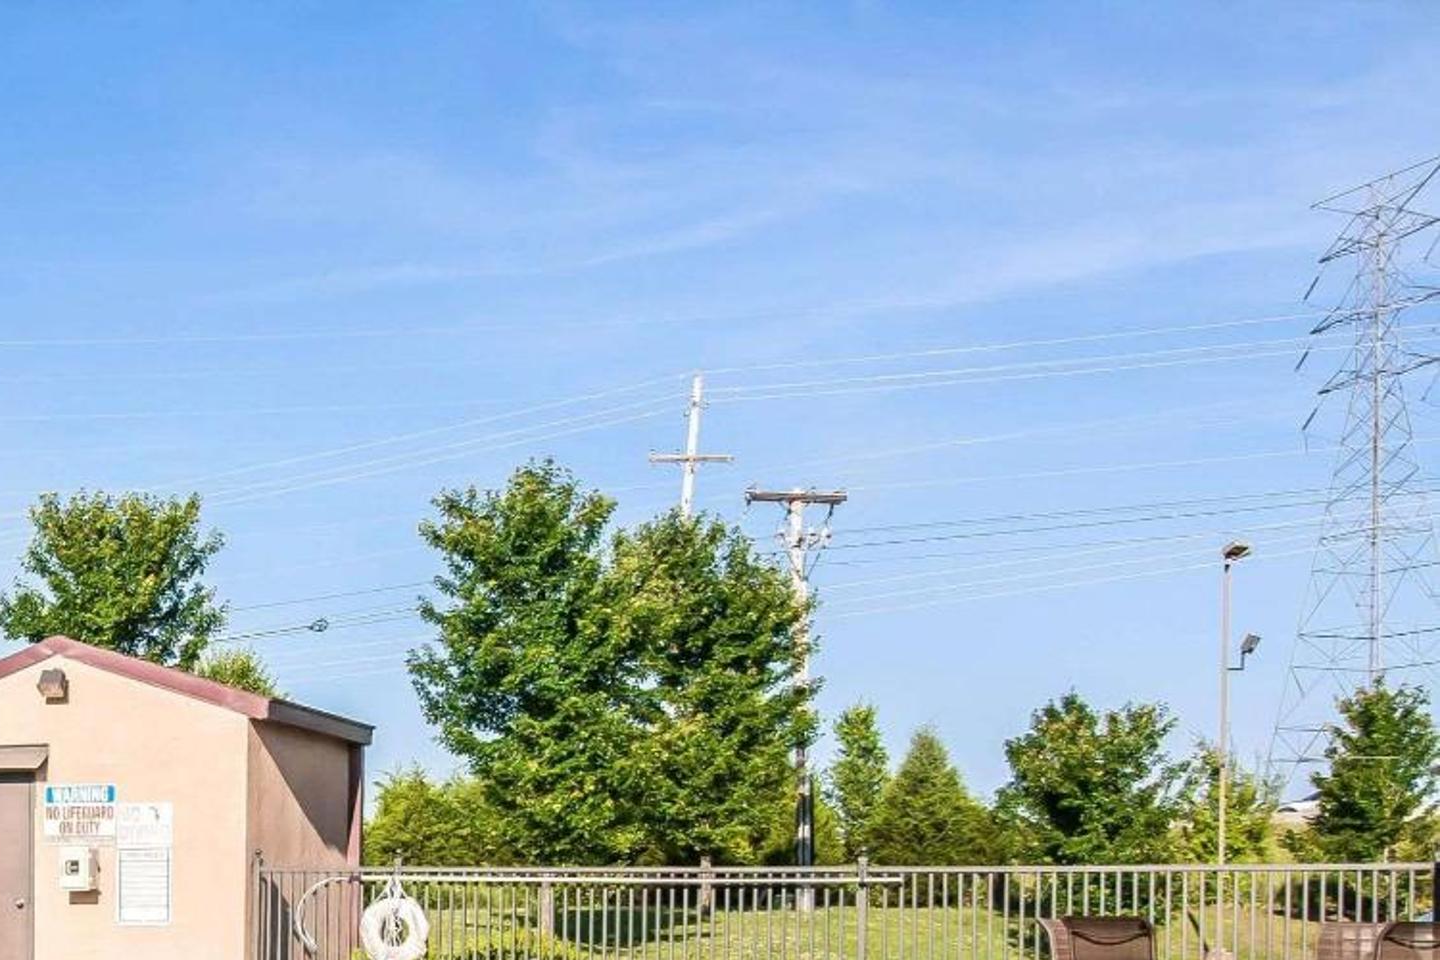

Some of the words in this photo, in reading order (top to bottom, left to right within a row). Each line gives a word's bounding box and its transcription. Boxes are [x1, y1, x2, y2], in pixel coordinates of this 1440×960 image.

[46, 806, 61, 820] NO
[62, 806, 114, 820] LIFEGUARD
[59, 821, 74, 834] ON
[76, 821, 100, 834] DUTY
